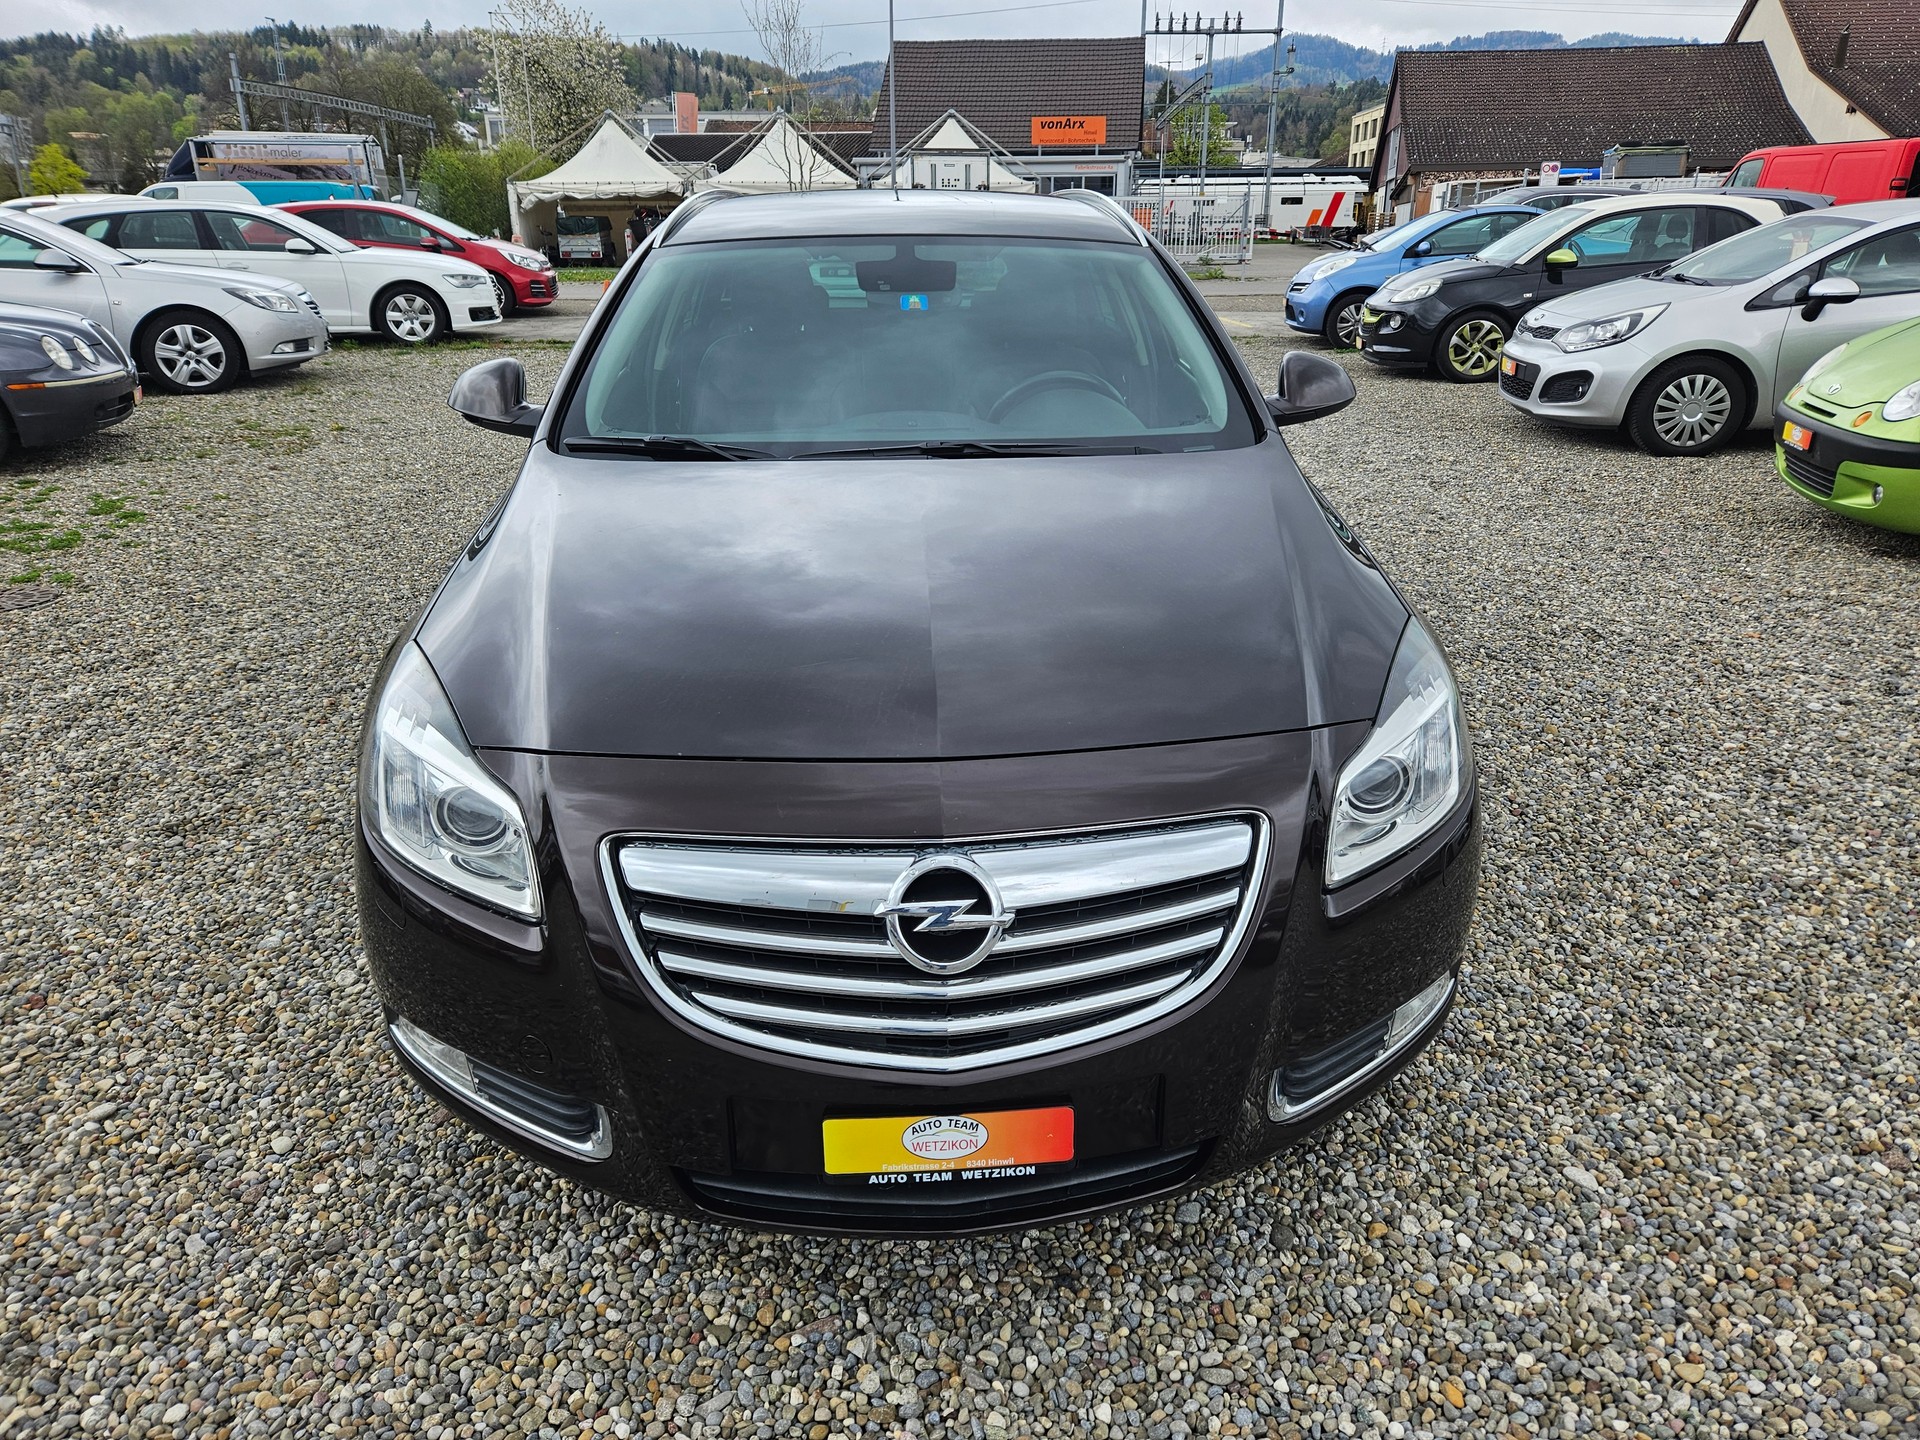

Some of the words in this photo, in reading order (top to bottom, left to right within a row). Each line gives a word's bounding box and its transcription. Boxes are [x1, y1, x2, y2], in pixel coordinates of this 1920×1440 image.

[1040, 118, 1085, 129] vonArx
[911, 1119, 942, 1135] AUTO
[947, 1118, 980, 1132] TEAM
[911, 1138, 979, 1152] WETZIKON
[882, 1163, 939, 1172] Fabrikstrasse
[941, 1161, 955, 1170] 2-4
[966, 1159, 986, 1168] 8340
[988, 1157, 1014, 1167] Hinwil
[868, 1174, 908, 1185] AUTO
[913, 1171, 953, 1183] TEAM
[961, 1165, 1036, 1180] WETZIKON
